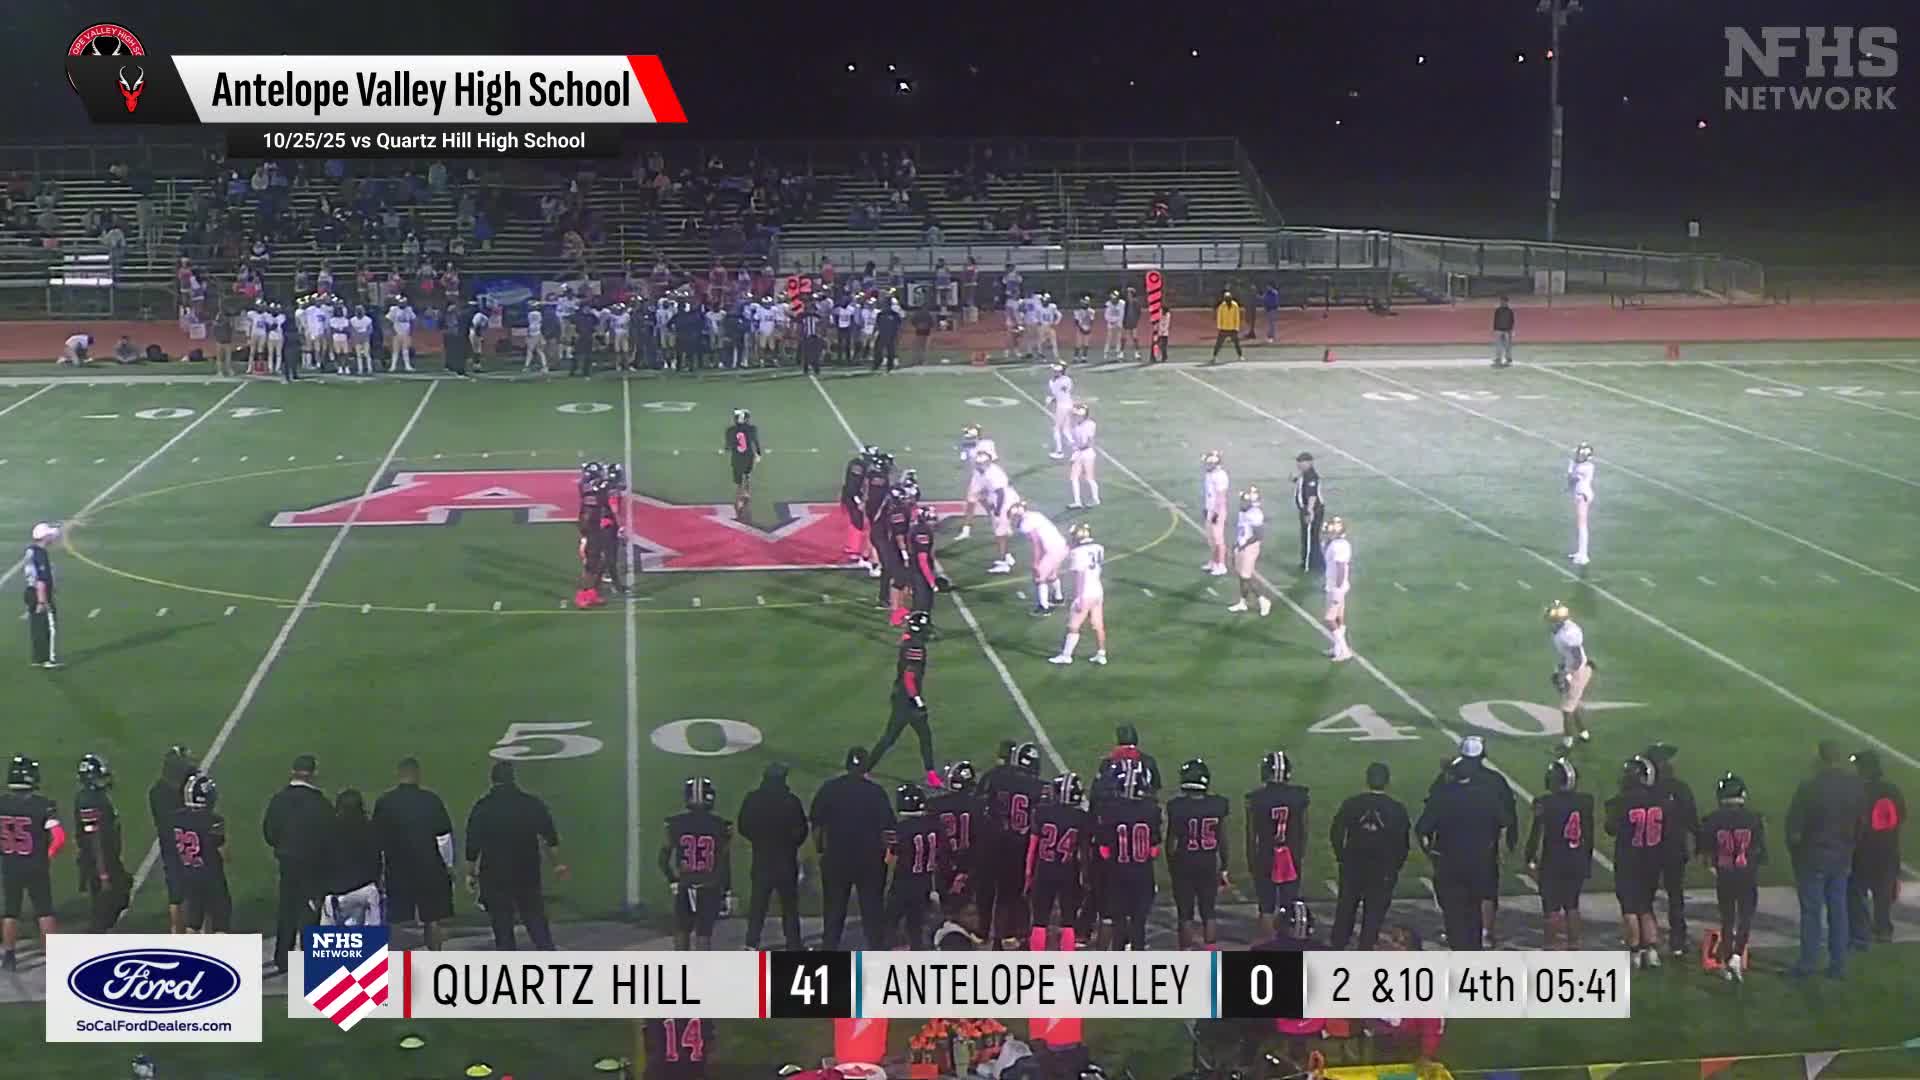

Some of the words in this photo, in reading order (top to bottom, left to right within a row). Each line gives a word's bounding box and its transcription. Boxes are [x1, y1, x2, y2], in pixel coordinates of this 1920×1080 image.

[736, 431, 746, 453] 3
[1039, 823, 1079, 863] 24
[1116, 823, 1150, 863] 10
[1187, 817, 1219, 851] 15
[1271, 806, 1289, 842] 7
[1563, 811, 1581, 849] 4
[1630, 806, 1662, 847] 76
[680, 834, 717, 873] 33
[912, 831, 936, 873] 11
[663, 1017, 705, 1063] 14
